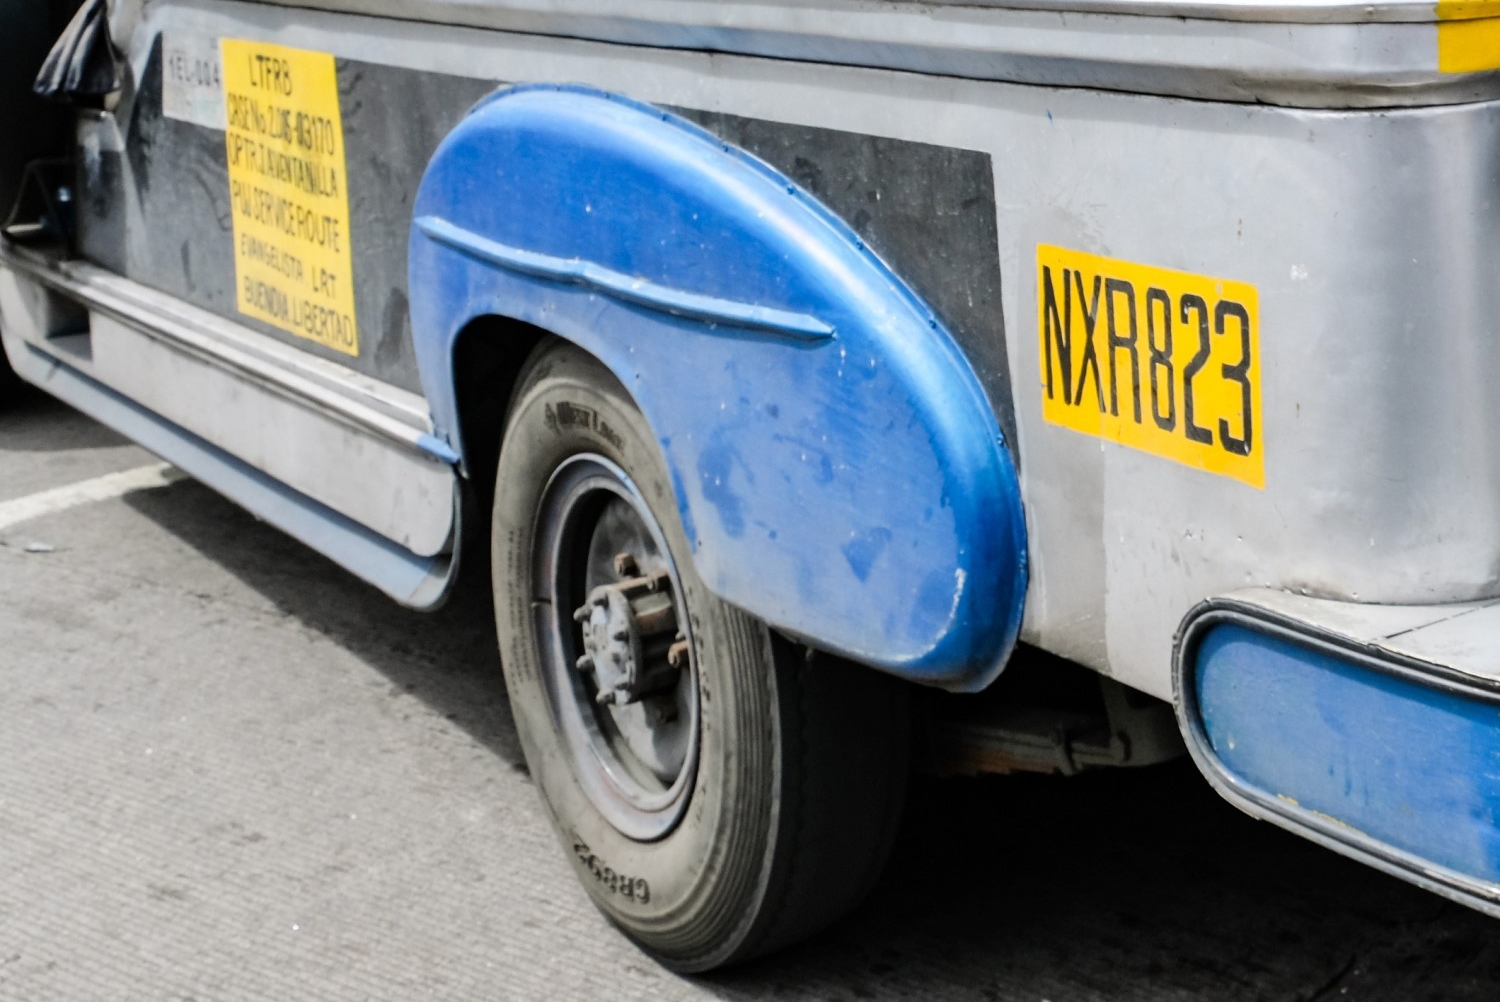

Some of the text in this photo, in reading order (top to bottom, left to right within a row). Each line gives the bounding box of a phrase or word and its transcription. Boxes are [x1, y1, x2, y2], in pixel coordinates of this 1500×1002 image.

[249, 53, 294, 97] LTFRB
[296, 204, 341, 254] ROUTE
[311, 264, 337, 299] LRT
[291, 293, 355, 348] LIBERTAD
[1043, 264, 1253, 457] NXR823
